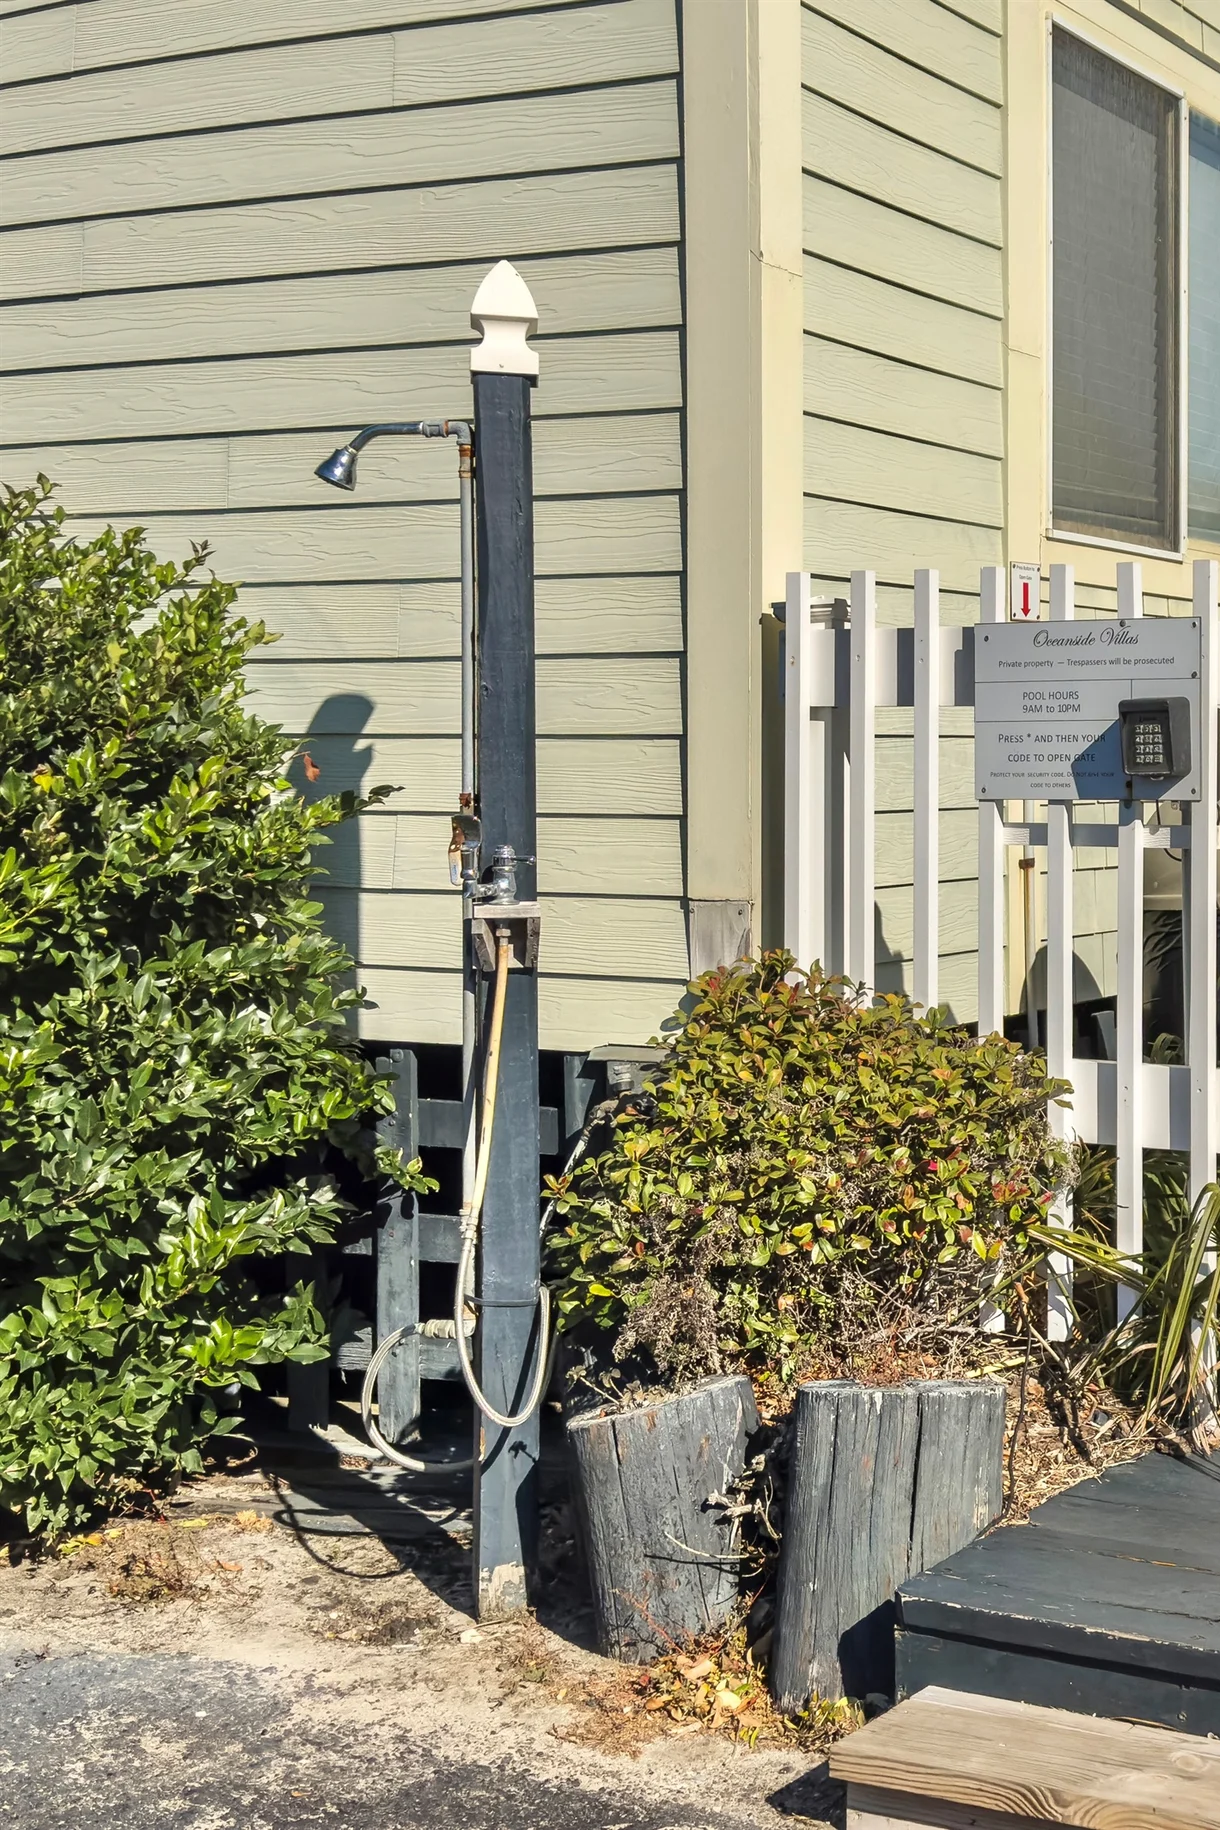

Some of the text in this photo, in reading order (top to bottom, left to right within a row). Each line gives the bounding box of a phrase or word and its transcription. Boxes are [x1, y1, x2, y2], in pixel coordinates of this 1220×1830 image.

[1033, 625, 1139, 648] Oceanside Villas
[998, 660, 1022, 668] Private
[1024, 660, 1054, 669] property
[1066, 658, 1108, 667] Trespassers
[1108, 657, 1122, 666] will
[1122, 657, 1132, 665] be
[1134, 656, 1175, 667] prosecuted
[1022, 691, 1080, 700] POOL HOURS
[1022, 704, 1081, 713] 9AM to 10PM
[1034, 734, 1053, 743] AND
[1056, 734, 1079, 743] THEN
[1081, 734, 1106, 743] YOUR
[1008, 753, 1096, 762] CODE TO OPEN GATE
